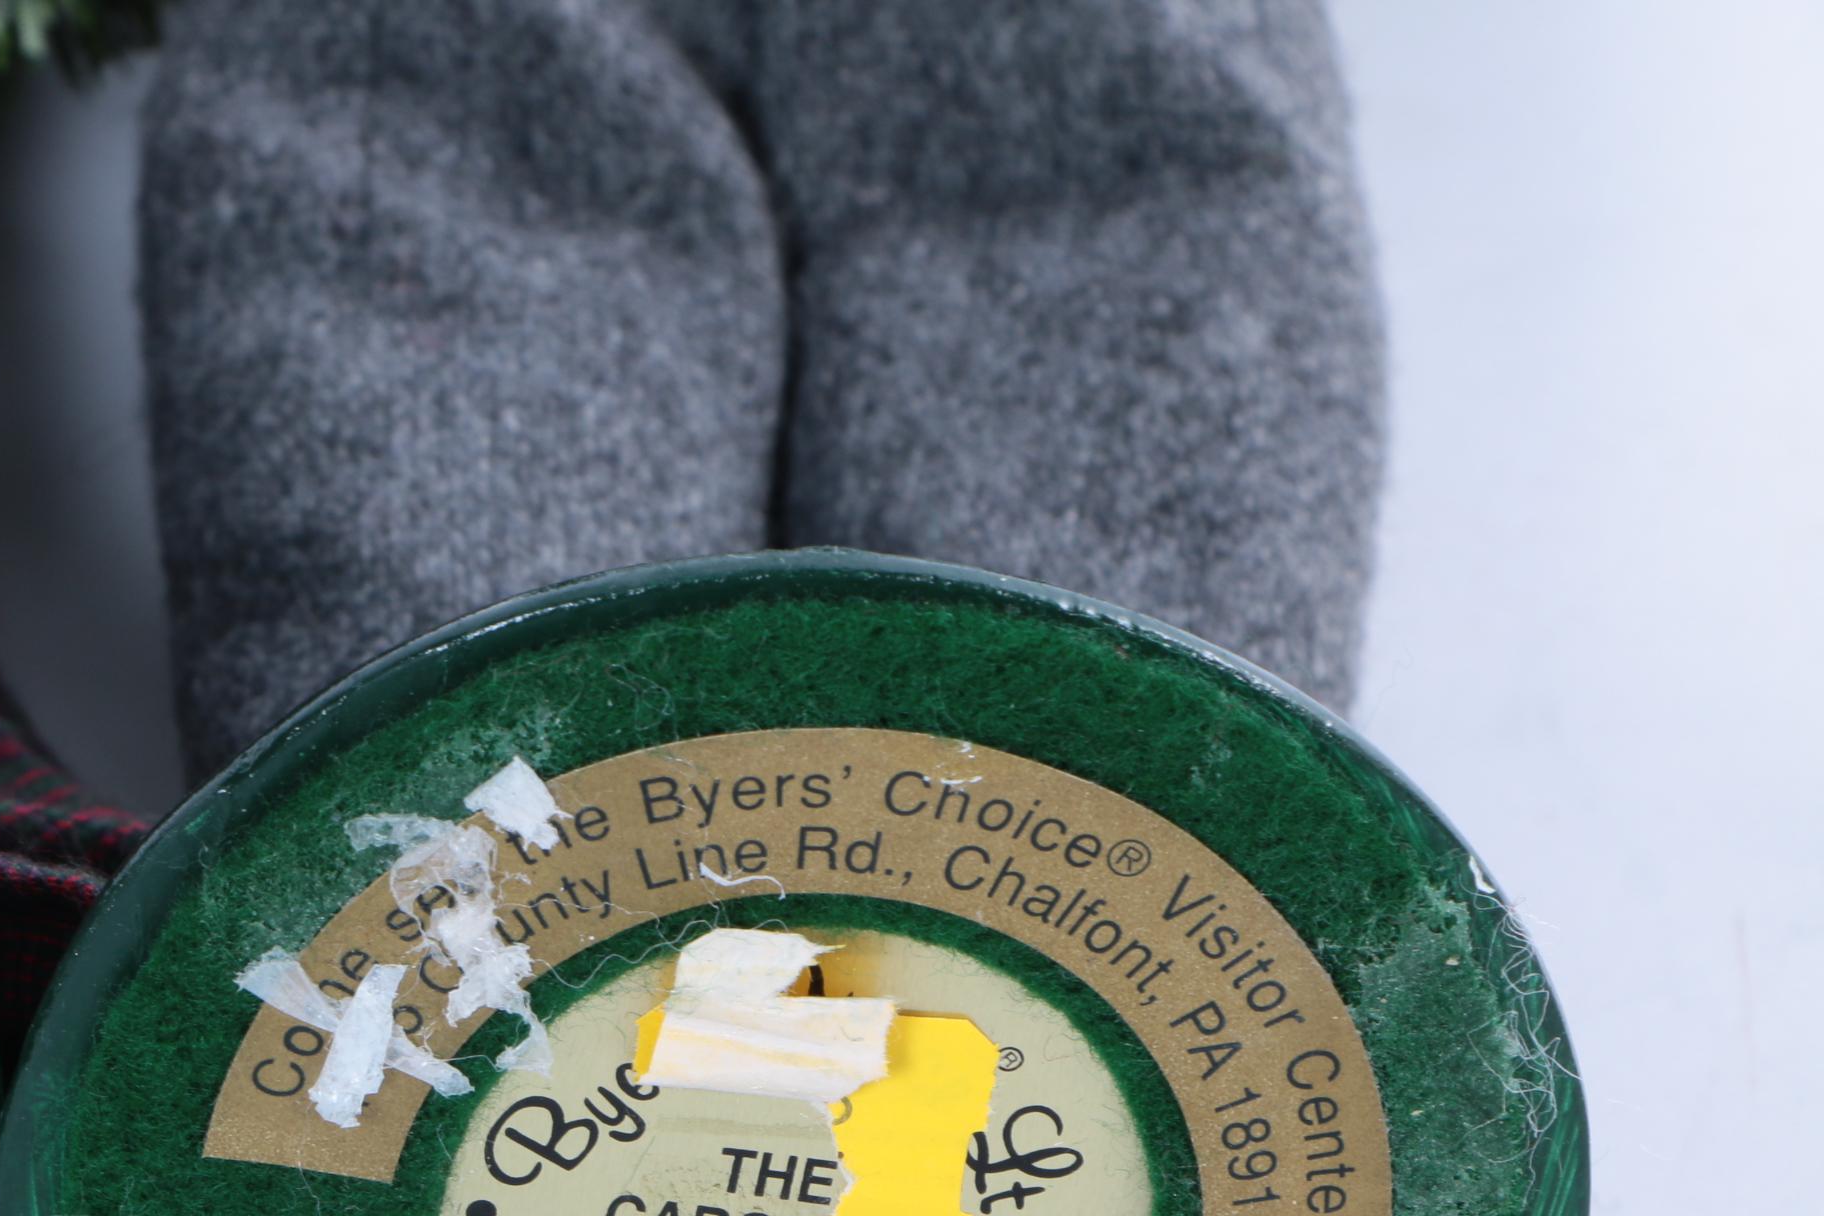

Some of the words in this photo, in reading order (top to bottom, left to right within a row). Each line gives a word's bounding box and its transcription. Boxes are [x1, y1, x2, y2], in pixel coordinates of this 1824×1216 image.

[419, 869, 613, 993] Cunty
[634, 836, 770, 892] Line
[796, 825, 914, 888] Rd.,
[943, 845, 1174, 1007] Chalfont,
[1169, 1001, 1243, 1080] PA
[640, 766, 853, 827] Byers'
[1160, 872, 1306, 1030] Visitor
[721, 1146, 838, 1206] THE
